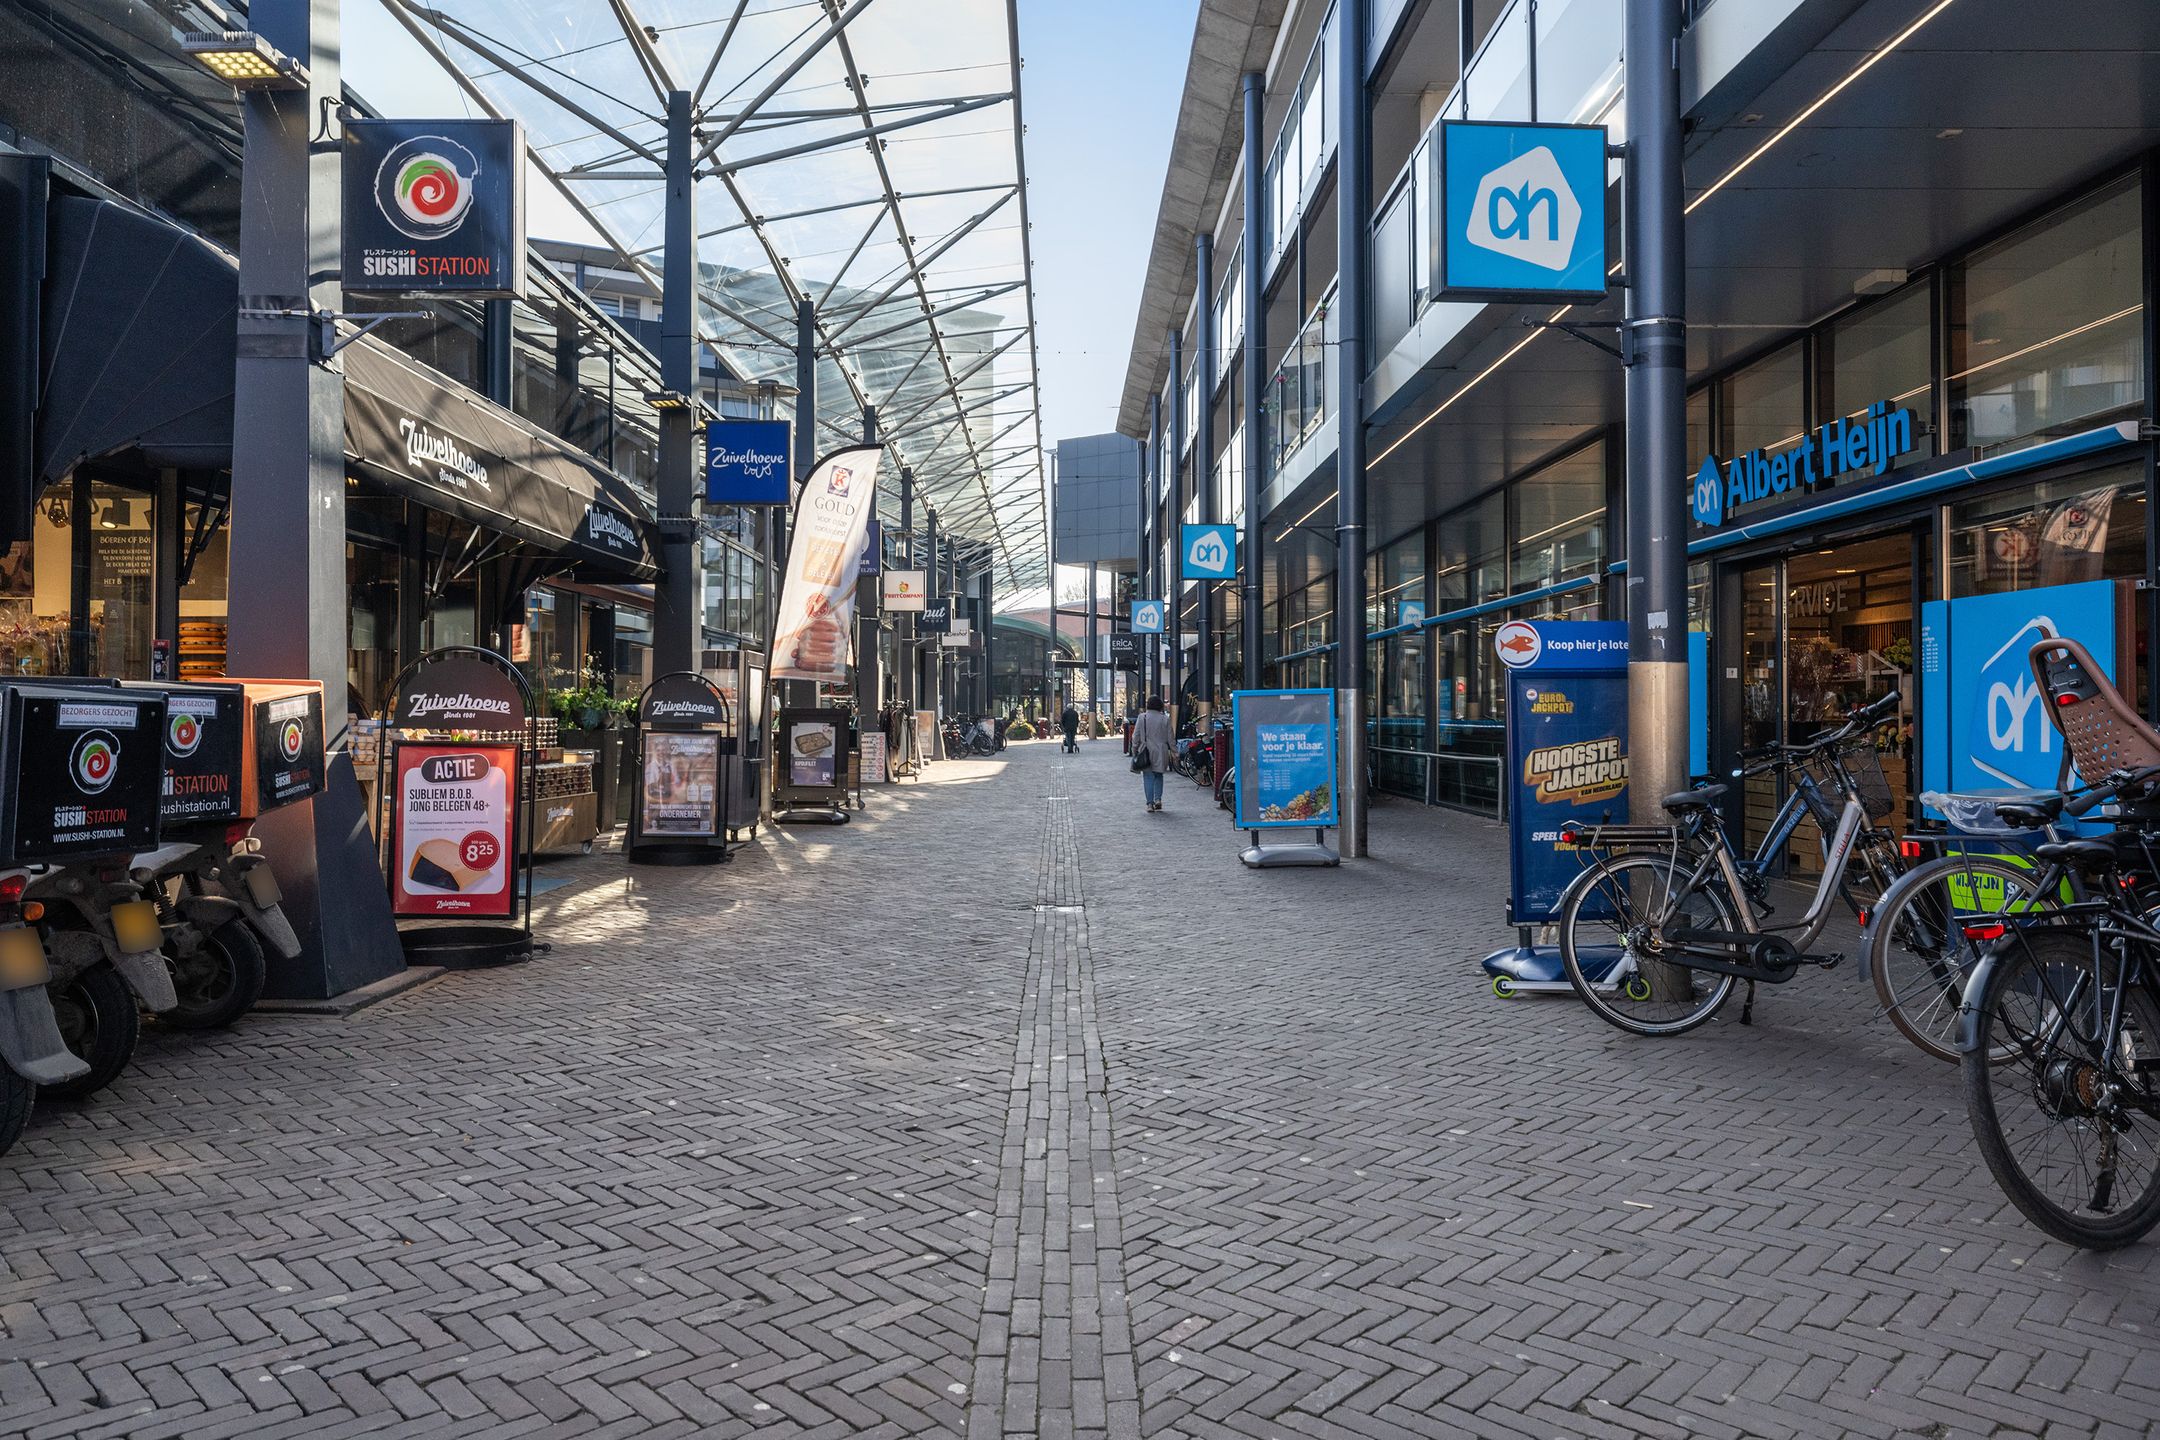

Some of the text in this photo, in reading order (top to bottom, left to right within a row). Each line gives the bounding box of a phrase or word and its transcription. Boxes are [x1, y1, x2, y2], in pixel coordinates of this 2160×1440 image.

[417, 257, 490, 276] STATION
[399, 418, 491, 492] Zuivelhoeve
[711, 447, 785, 468] Zuivelhoeve
[1726, 400, 1911, 508] Albert Heijn
[814, 496, 855, 516] GOUD
[585, 504, 638, 547] Zuivelhoeve
[100, 536, 127, 544] BOEREN
[127, 536, 138, 544] OF
[1790, 579, 1849, 618] RVICE
[922, 606, 946, 620] put
[1547, 639, 1574, 652] Koop
[1575, 639, 1596, 650] hier
[1597, 639, 1608, 652] je
[61, 707, 135, 717] BEZORGERS GEZOCHT!
[408, 693, 511, 718] Zuivelhoeve
[652, 700, 716, 716] Zuivelhoeve
[1262, 732, 1306, 742] We staan
[1262, 741, 1324, 753] voor je klaar.
[1533, 739, 1619, 774] HOOGSTE
[434, 758, 476, 780] ACTIE
[1546, 758, 1629, 792] JACKPOT
[174, 774, 229, 795] STATION
[1592, 783, 1623, 794] NEDERLAND
[409, 788, 474, 800] SUBLIEM B.O.B.
[409, 800, 490, 812] JONG BELEGEN 48+
[660, 809, 701, 818] ONDERNEMER
[86, 808, 127, 825] STATION
[1784, 803, 1806, 833] GAZELLE
[53, 828, 126, 843] WWW.SUSHI-STATION.NL
[1531, 831, 1558, 842] SPEEL
